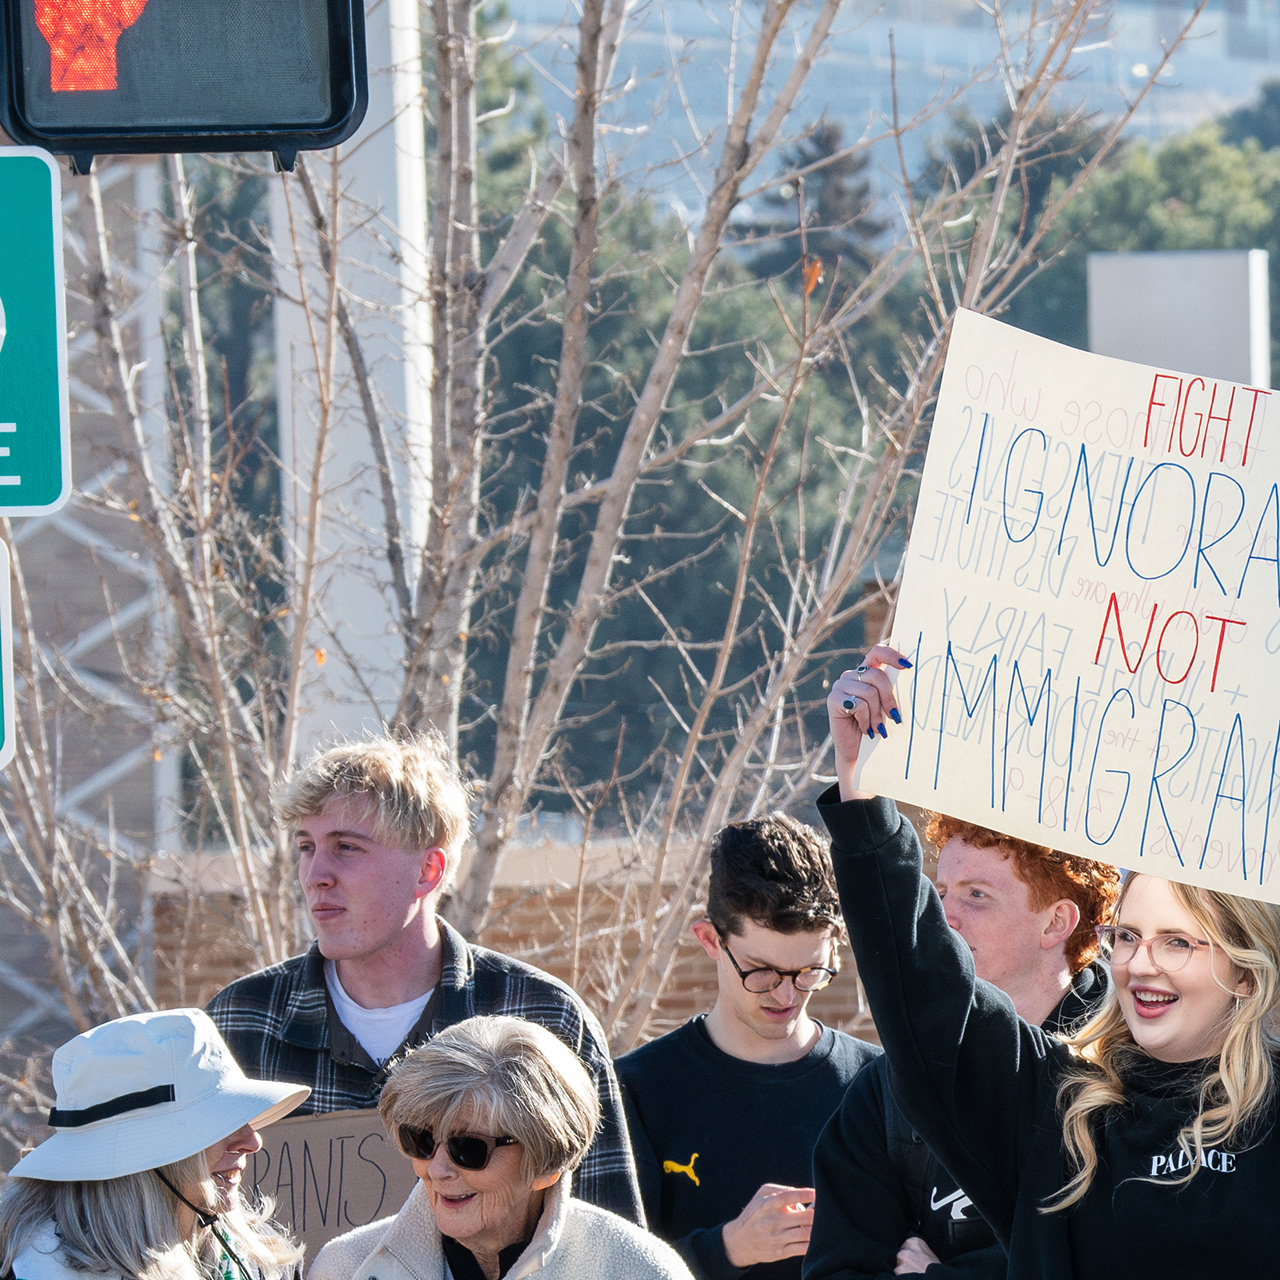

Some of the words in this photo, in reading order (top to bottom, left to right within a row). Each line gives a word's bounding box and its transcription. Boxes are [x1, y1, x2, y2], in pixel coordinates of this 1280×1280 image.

[1144, 373, 1271, 468] FIGHT
[1094, 592, 1247, 693] NOT
[1149, 1147, 1236, 1176] PALACE
